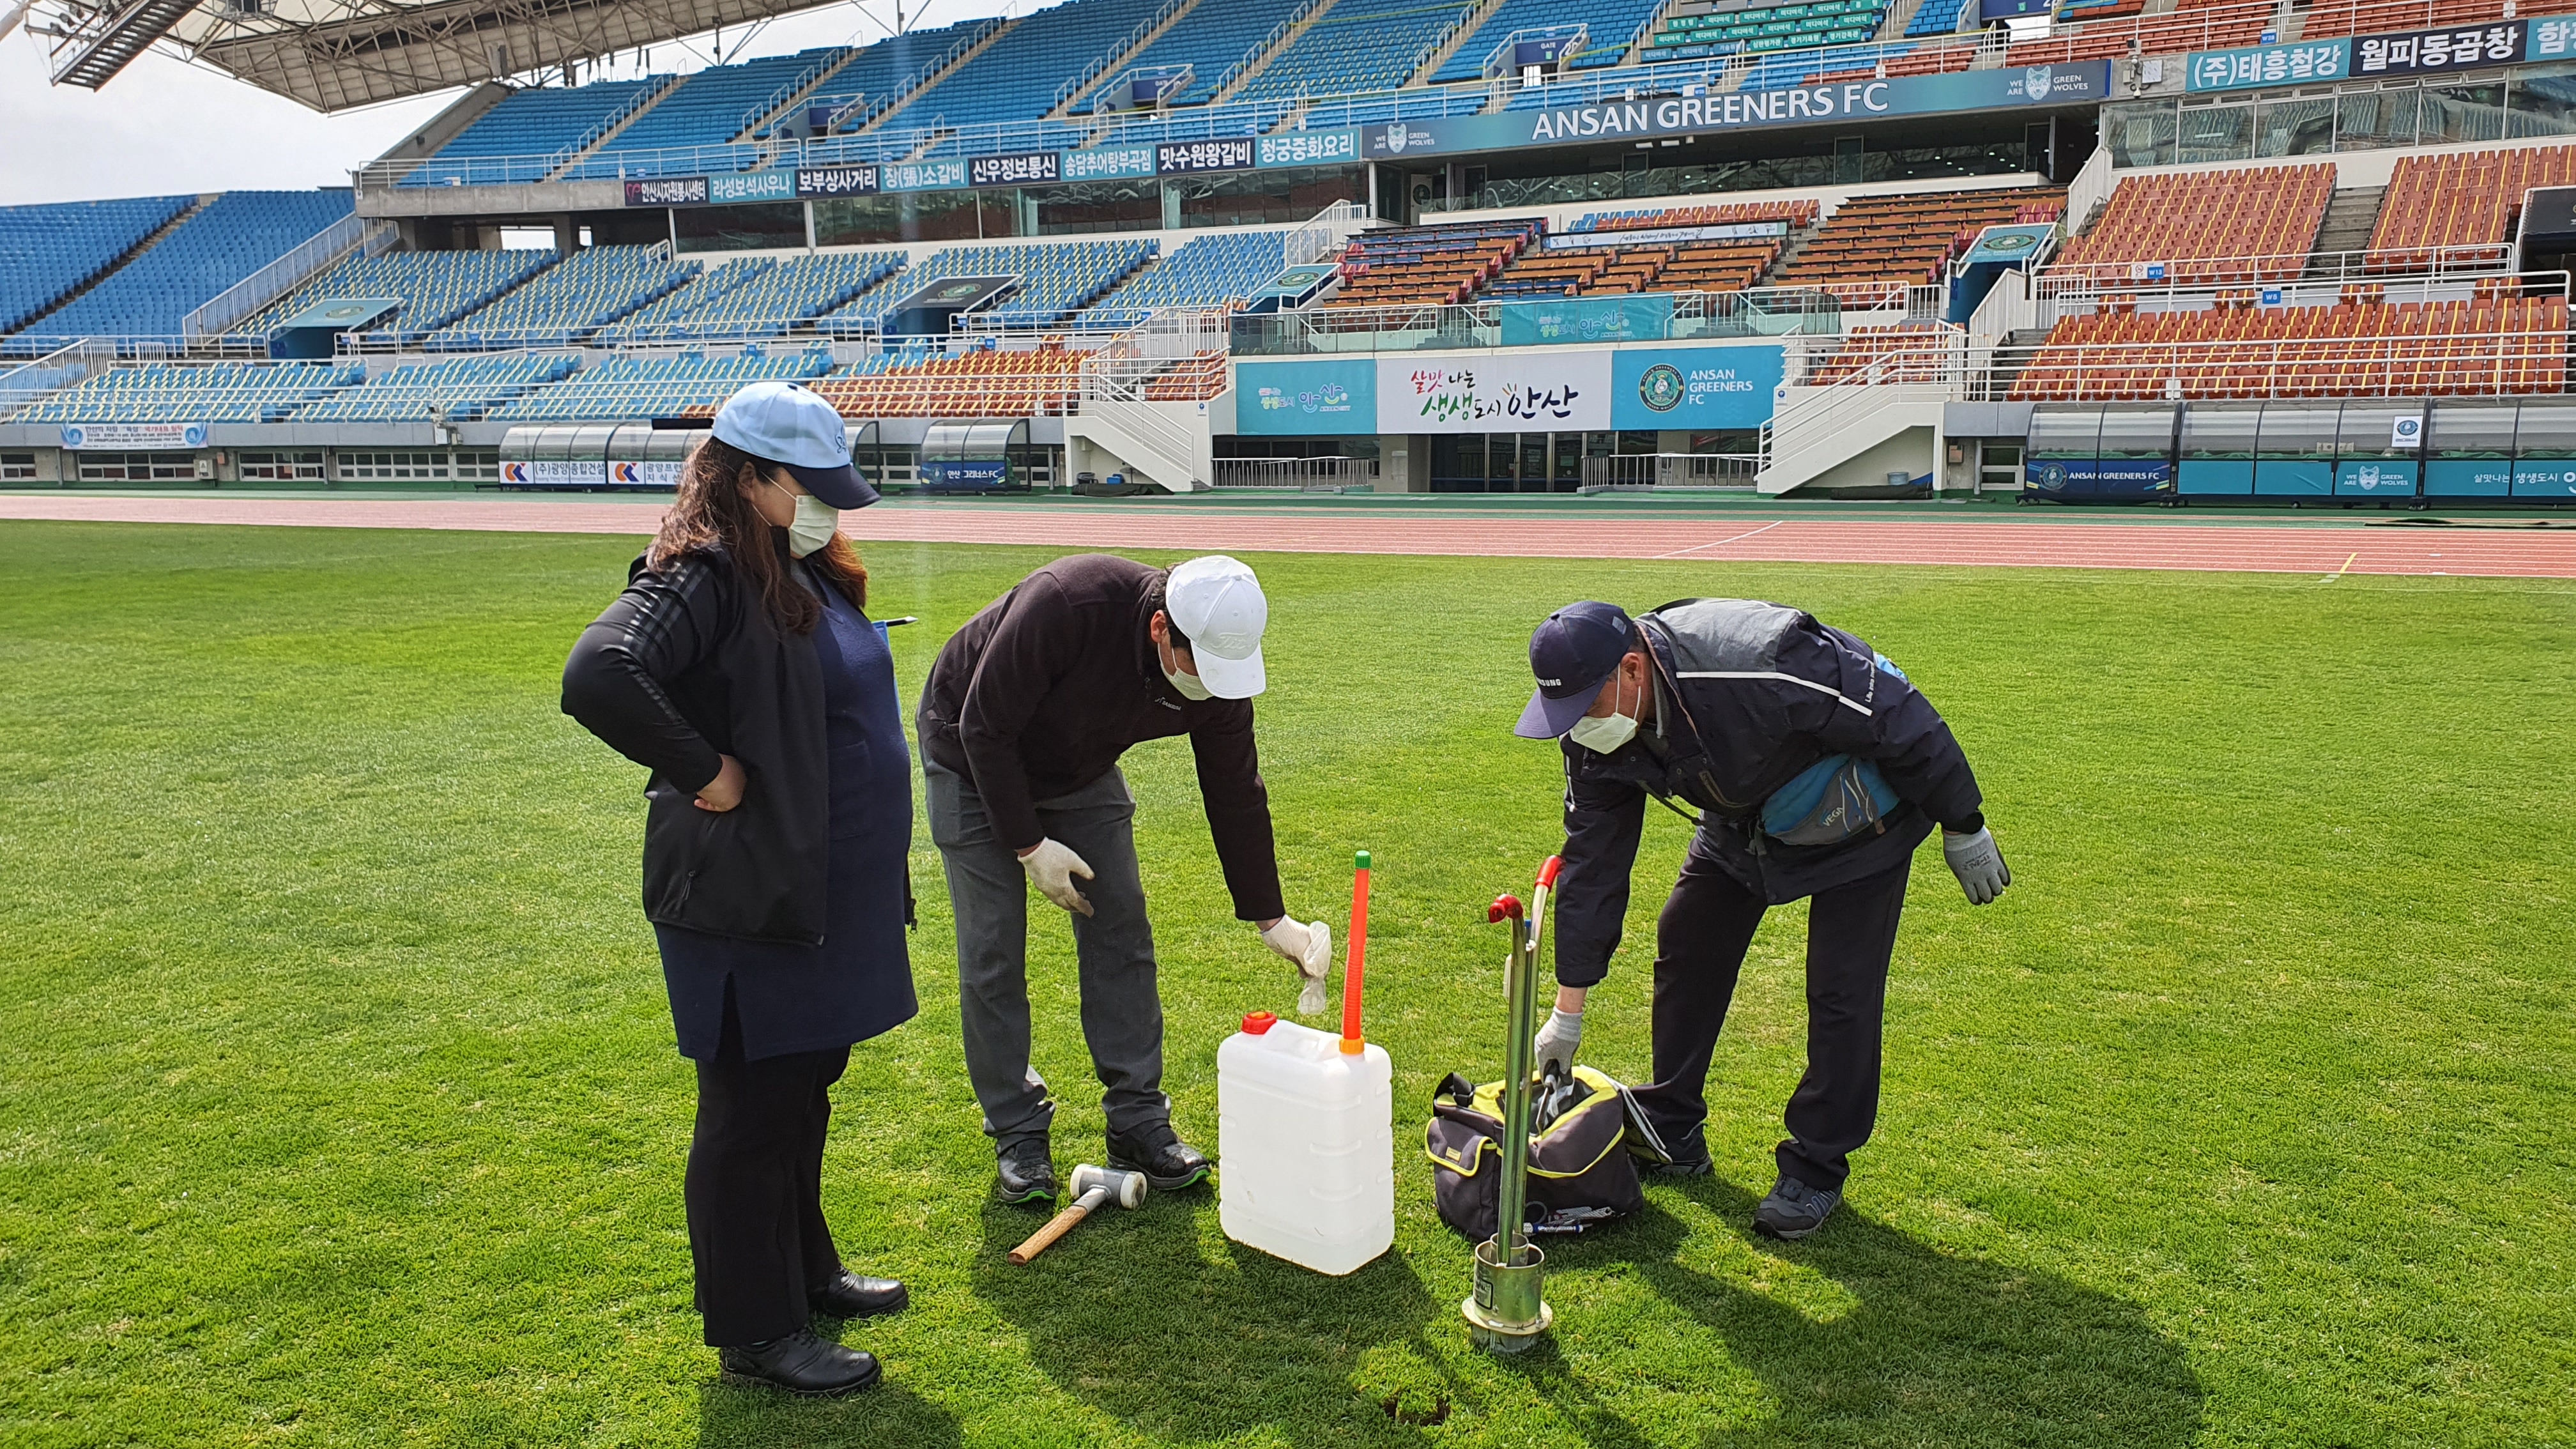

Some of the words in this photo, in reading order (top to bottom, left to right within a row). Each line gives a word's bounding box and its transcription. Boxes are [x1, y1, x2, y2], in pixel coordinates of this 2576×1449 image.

[2359, 26, 2518, 72] 월피동곱창
[2194, 44, 2342, 88] (주)태흥철강
[2053, 75, 2082, 84] GREEN
[2053, 82, 2089, 91] WOLVES
[2007, 88, 2023, 96] ARE
[1531, 103, 1650, 141] ANSAN
[1656, 86, 1835, 129] GREENERS
[1843, 82, 1890, 114] FC
[1260, 132, 1354, 164] 청궁중화요리
[1408, 138, 1435, 146] WOLVES
[1160, 140, 1252, 171] 맛수원왕갈비
[972, 155, 1056, 183] 신우정보통신
[712, 173, 791, 199] 라성보석사우나
[799, 167, 877, 193] 보부상사거리
[1411, 369, 1445, 394] 살맛
[1448, 369, 1476, 389] 나는
[1689, 369, 1735, 381] ANSAN
[1689, 380, 1753, 393] GREENERS
[1505, 383, 1579, 419] 안산
[1689, 394, 1705, 405] FC
[947, 470, 961, 479] 안산
[2103, 471, 2147, 480] GREENERS
[2474, 473, 2510, 483] 살맛나는
[2515, 472, 2558, 484] 생생도시
